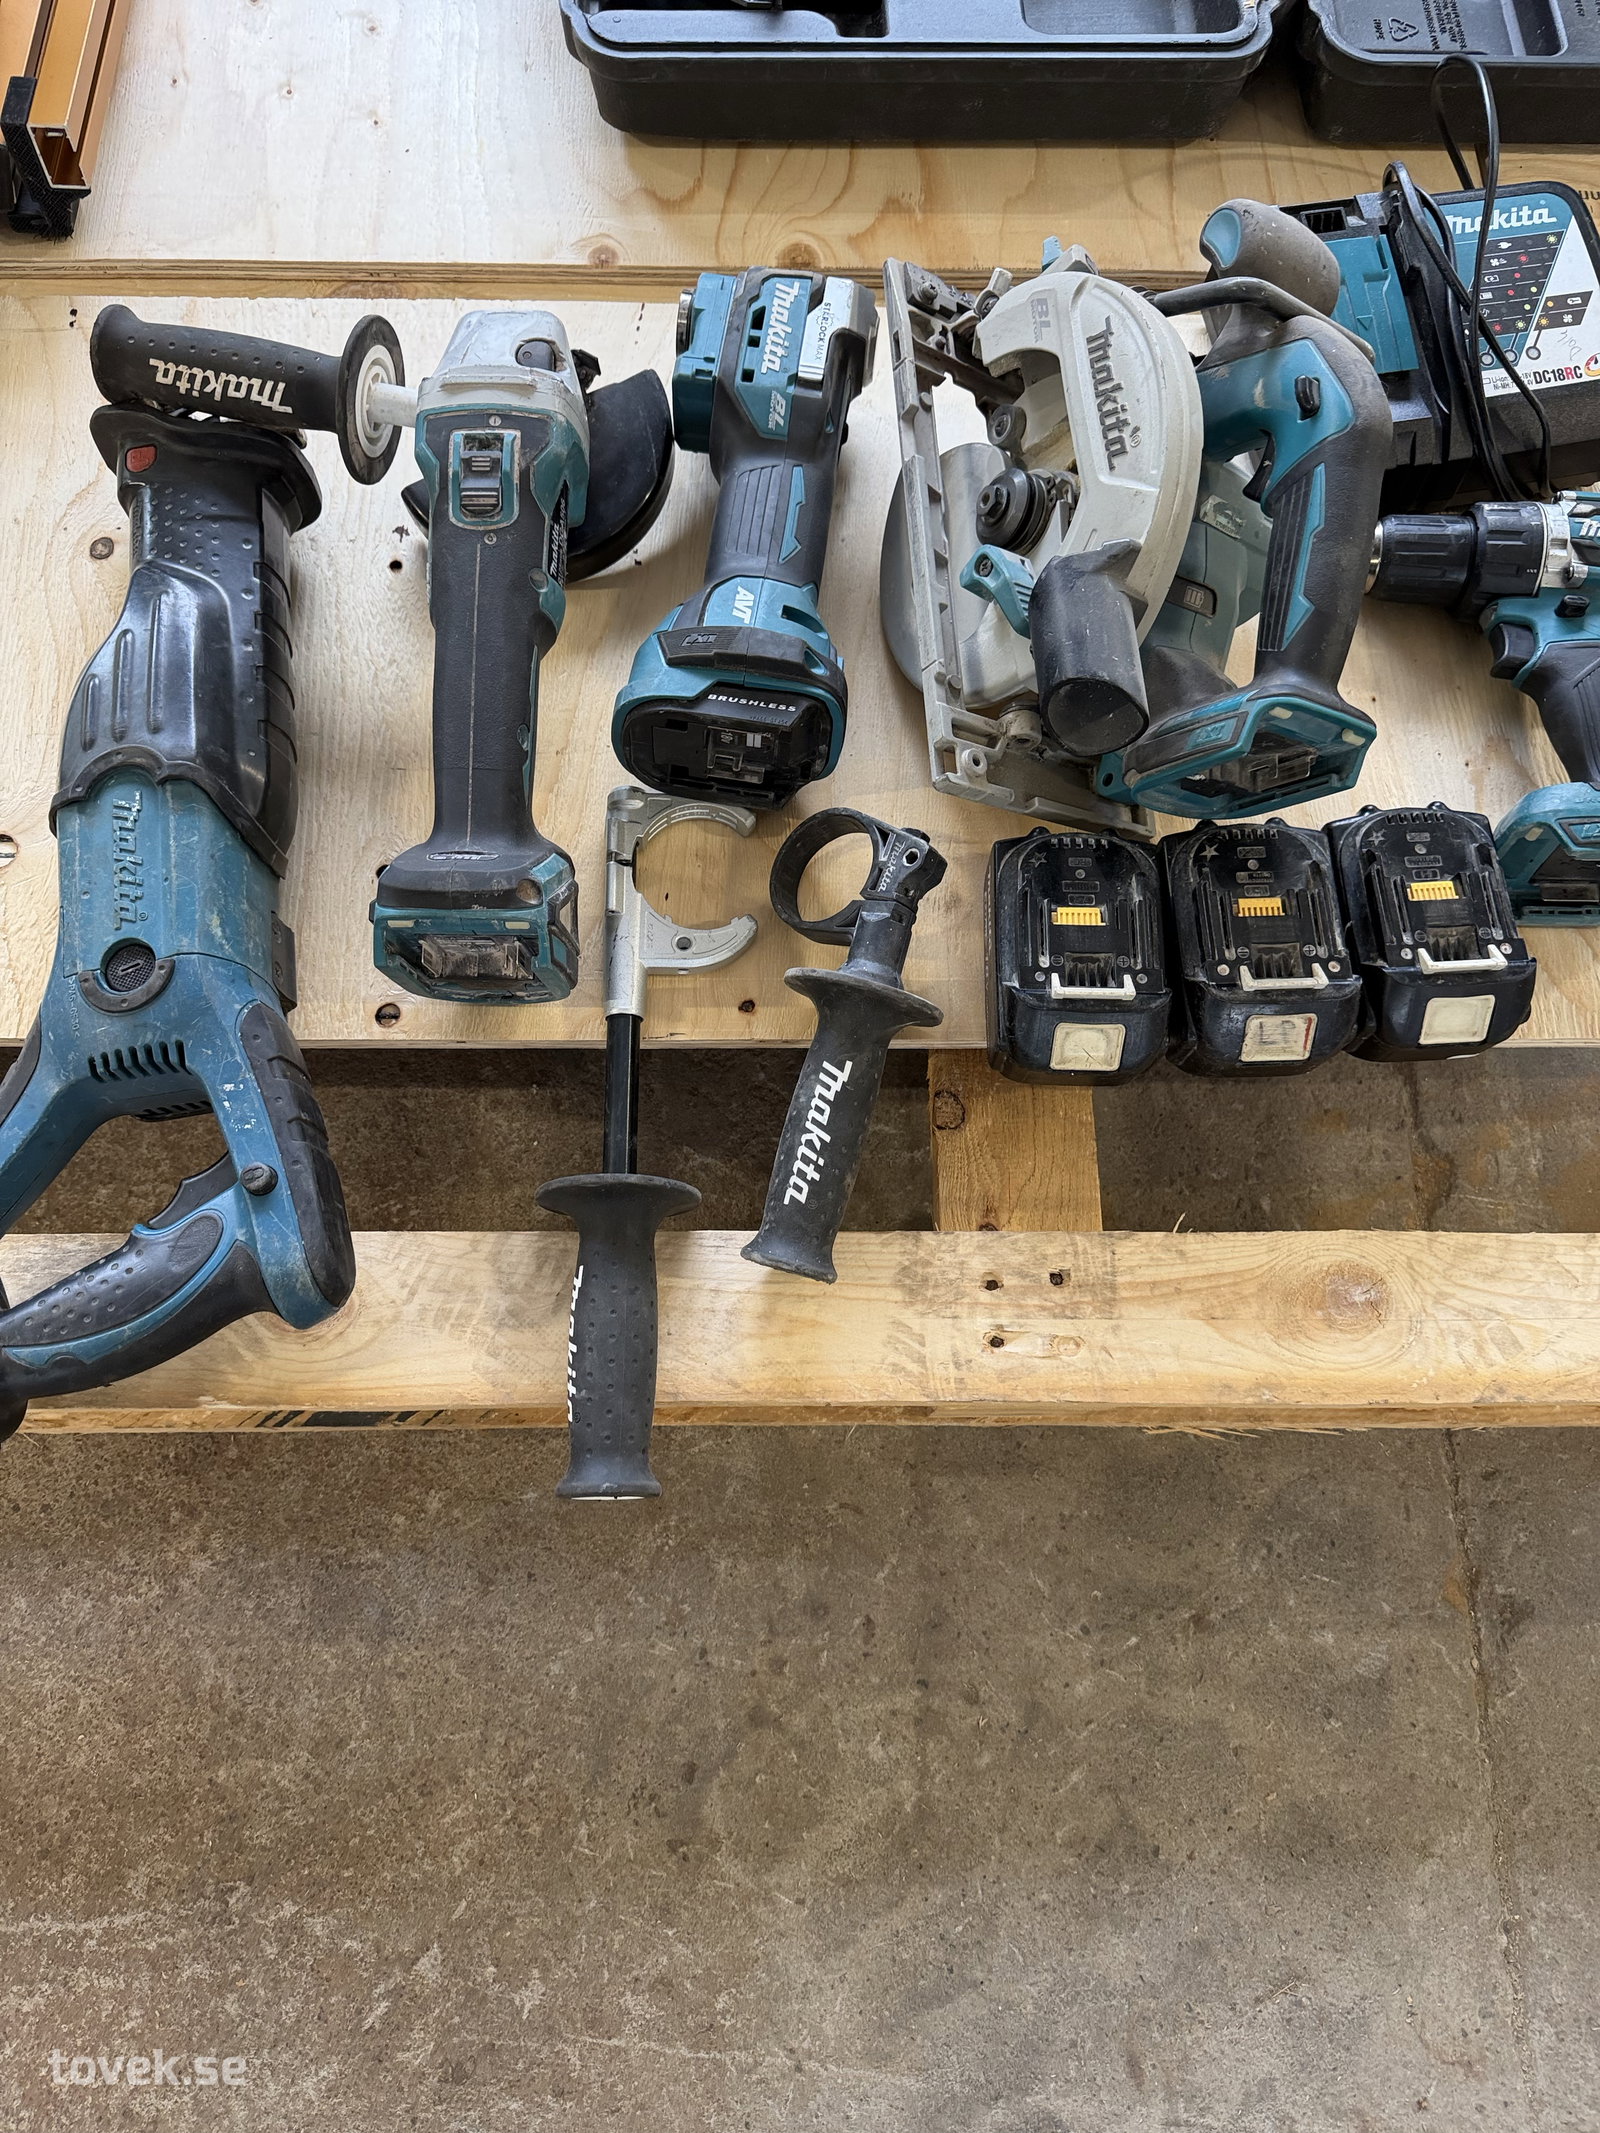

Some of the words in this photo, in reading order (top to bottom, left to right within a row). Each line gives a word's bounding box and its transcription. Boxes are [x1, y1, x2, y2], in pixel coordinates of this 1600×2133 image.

[1037, 297, 1051, 341] BL
[1533, 366, 1583, 385] DC18RC
[772, 393, 786, 432] BL
[732, 585, 755, 624] AVT
[707, 694, 797, 712] BRUSHLESS
